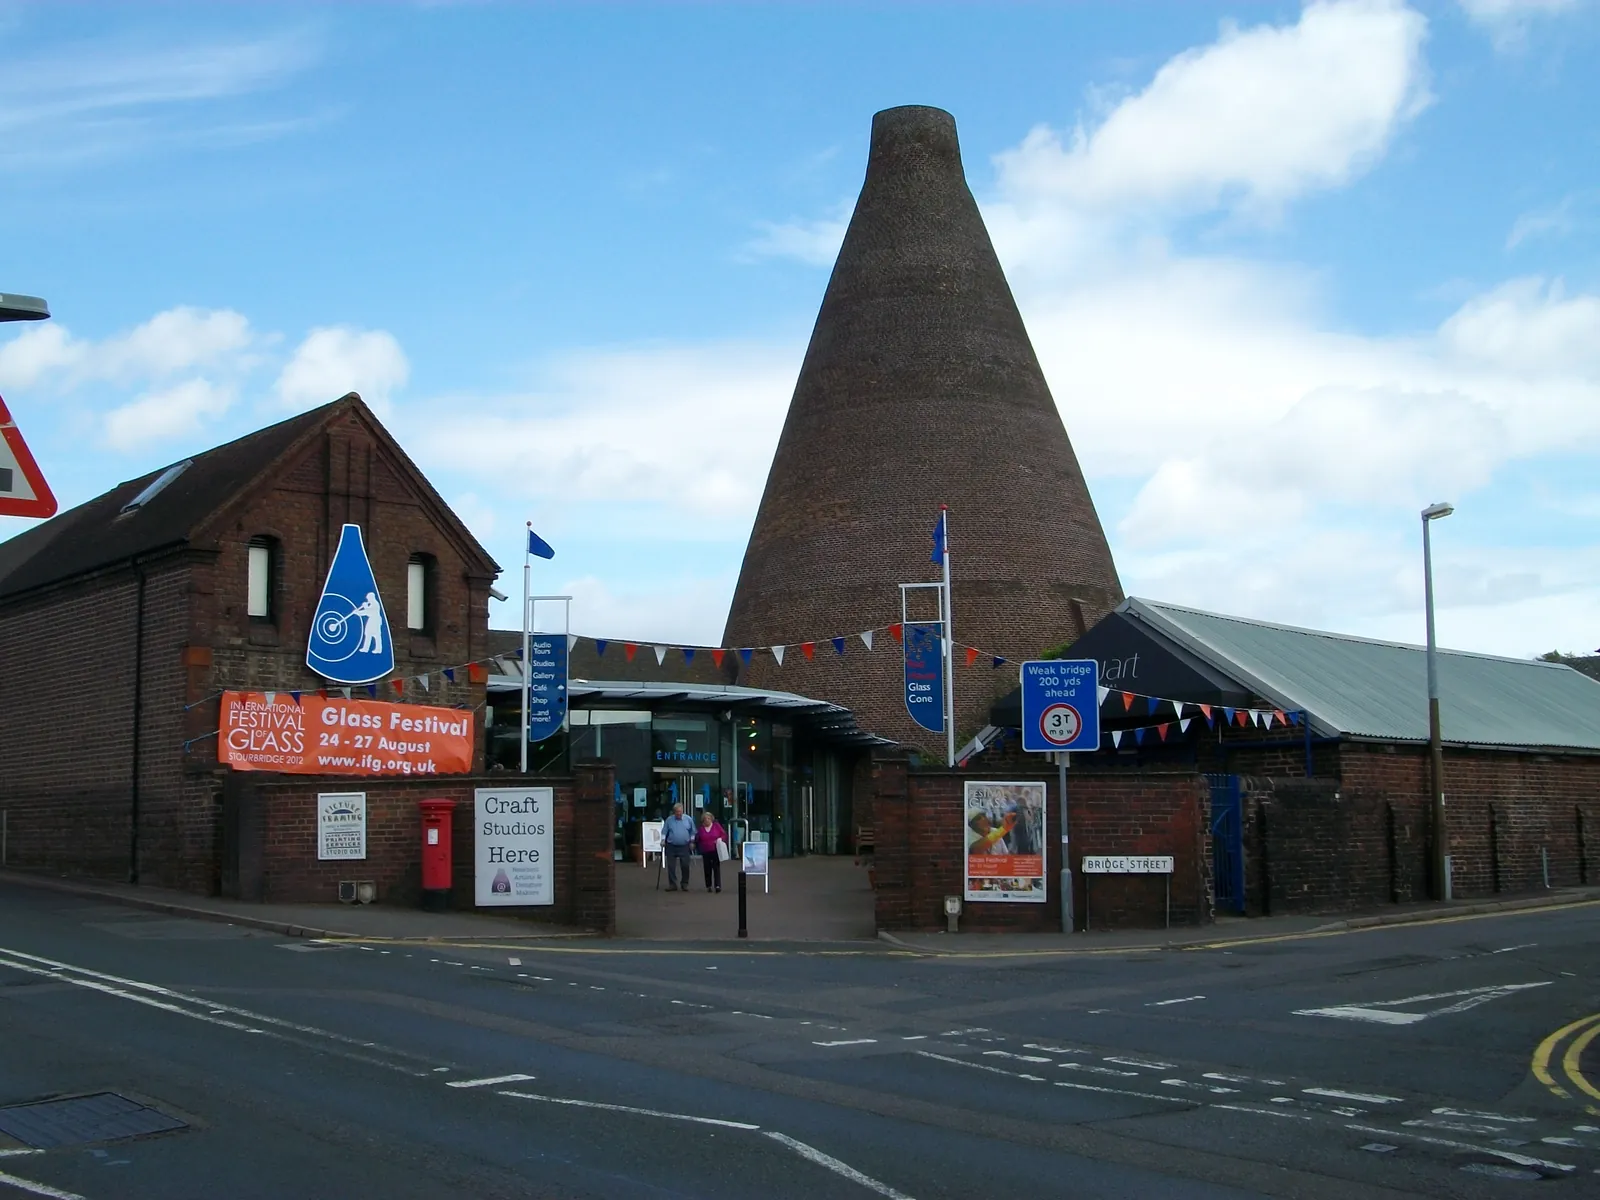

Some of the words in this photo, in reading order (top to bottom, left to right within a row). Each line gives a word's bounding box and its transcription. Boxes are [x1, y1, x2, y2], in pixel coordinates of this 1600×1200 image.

[533, 641, 551, 649] Audio
[532, 672, 555, 680] Gallery
[1028, 666, 1056, 675] Weak
[1060, 665, 1092, 676] bridge
[908, 682, 931, 692] Glass
[1039, 677, 1059, 686] 200
[1064, 677, 1081, 687] yds
[908, 694, 933, 703] Cone
[1045, 689, 1076, 698] ahead
[532, 697, 548, 705] Shop
[229, 710, 305, 731] FESTIVAL
[321, 707, 382, 729] Glass
[390, 712, 468, 737] Festival
[255, 730, 267, 738] OF
[228, 728, 304, 753] GLASS
[319, 733, 339, 747] 24
[354, 735, 373, 748] 27
[378, 737, 431, 754] August
[228, 752, 284, 764] STOURBRIDGE
[286, 756, 304, 765] 2012
[656, 751, 718, 762] ENTRANCE
[318, 754, 436, 774] www.ifg.org.uk
[485, 797, 539, 814] Craft
[483, 821, 545, 836] Studios
[488, 846, 540, 863] Here
[1087, 860, 1125, 869] BRIDGE
[1130, 860, 1167, 869] STREET
